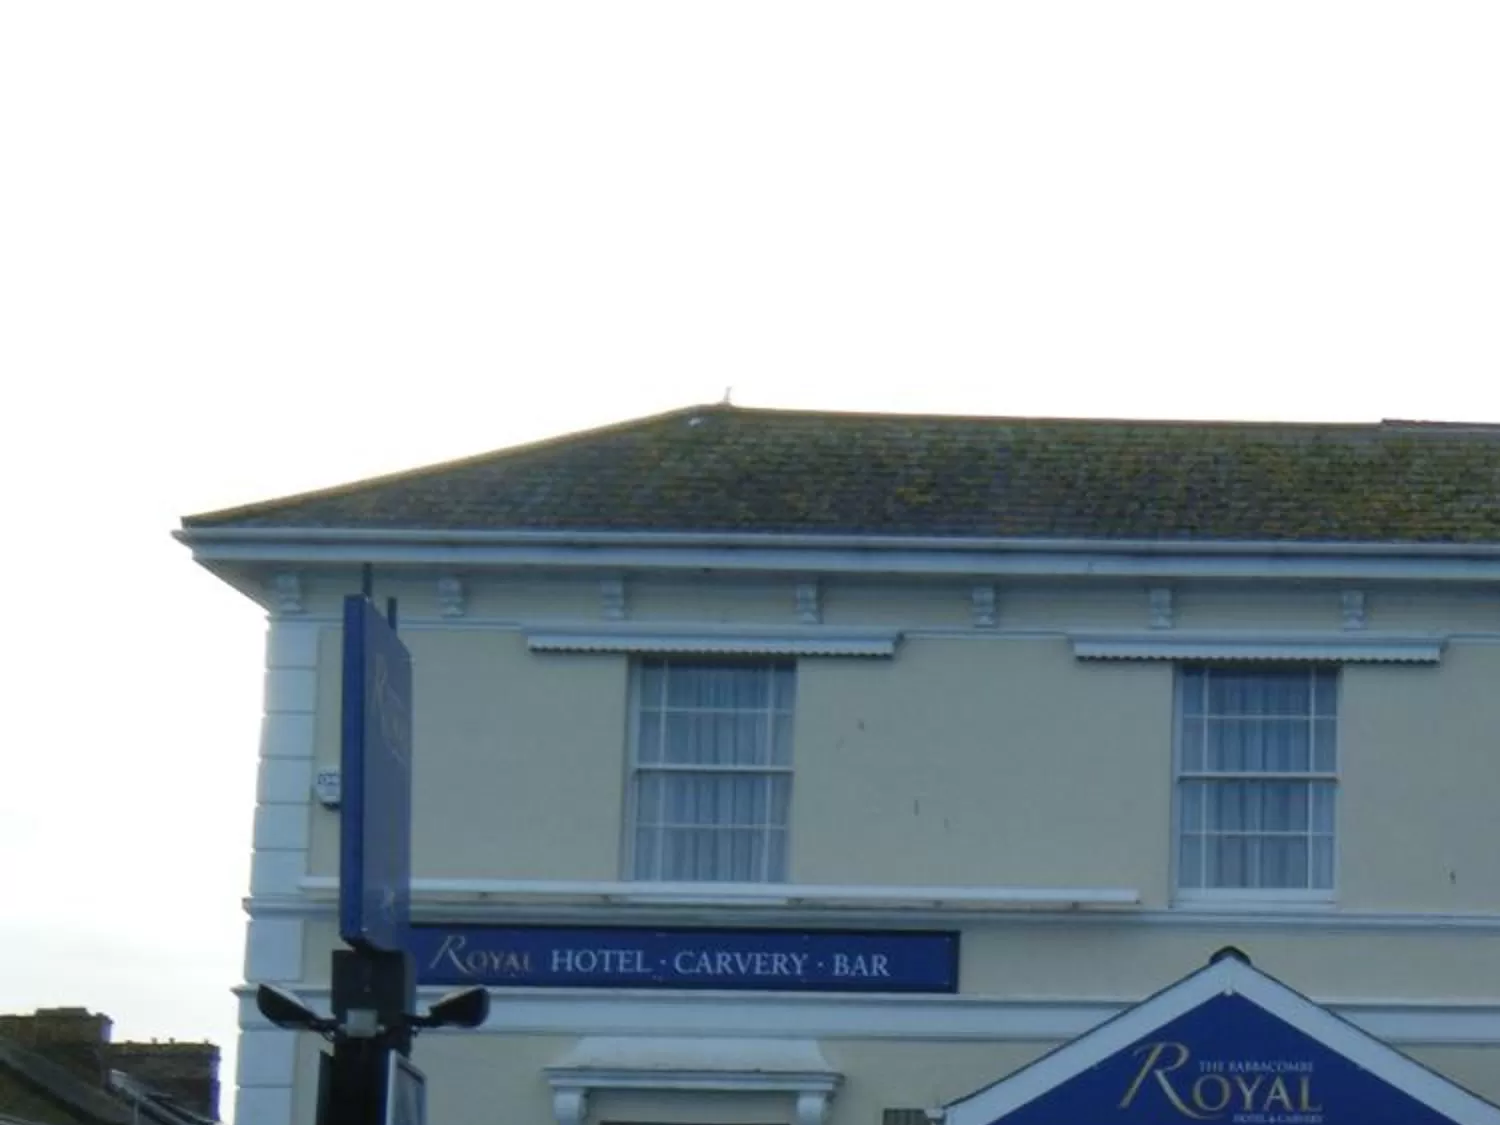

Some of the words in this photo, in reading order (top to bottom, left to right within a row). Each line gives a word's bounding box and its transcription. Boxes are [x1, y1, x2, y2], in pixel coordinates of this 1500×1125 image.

[429, 934, 532, 978] ROYAL
[550, 948, 653, 975] HOTEL
[673, 950, 810, 977] CARVERY
[831, 953, 891, 978] BAR
[1117, 1041, 1324, 1120] ROYAL
